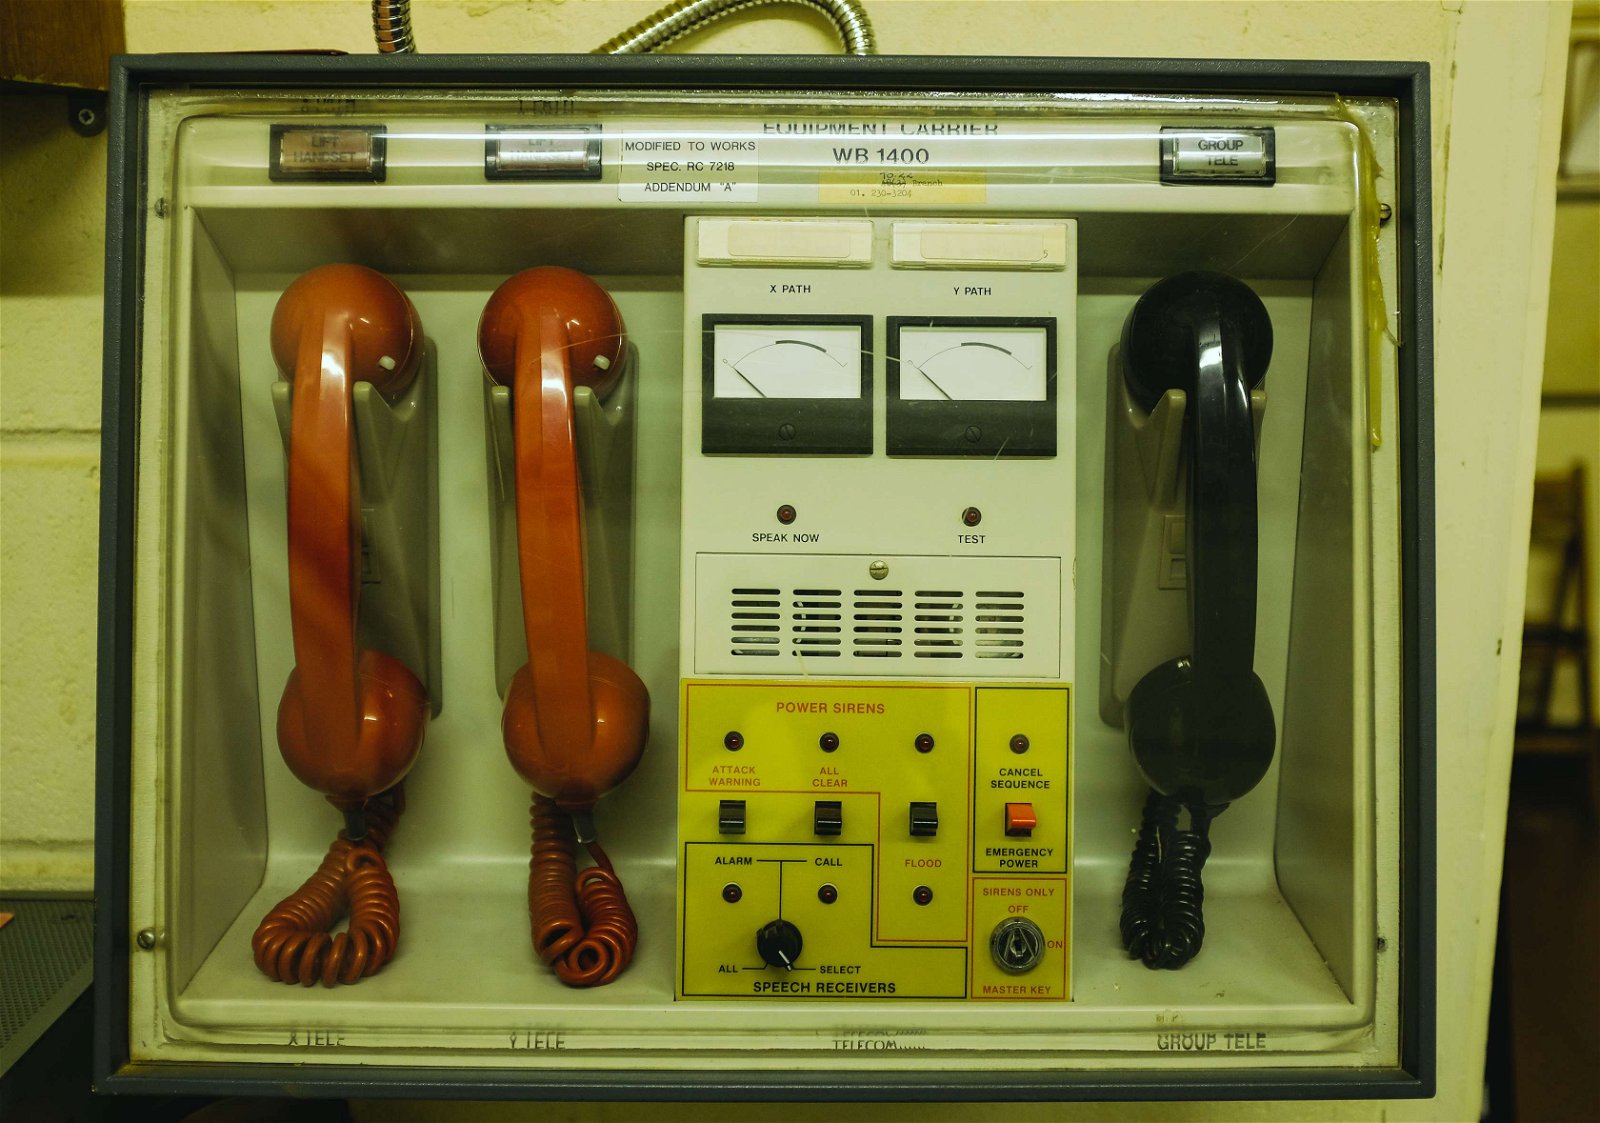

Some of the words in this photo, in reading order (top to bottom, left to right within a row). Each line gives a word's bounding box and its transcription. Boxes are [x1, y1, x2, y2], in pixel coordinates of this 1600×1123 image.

[625, 140, 681, 151] MODIFIED
[688, 141, 705, 151] TO
[710, 140, 756, 151] WORKS
[1197, 139, 1244, 151] GROUP
[832, 147, 869, 163] WB
[876, 147, 930, 164] 1400
[1207, 155, 1239, 166] TELE
[646, 162, 682, 172] SPEC.
[686, 162, 704, 172] RC
[709, 161, 735, 172] 7218
[644, 181, 711, 193] ADDENDUM
[769, 284, 777, 294] X
[782, 284, 812, 294] PATH
[953, 286, 960, 297] Y
[964, 286, 992, 297] PATH
[752, 532, 788, 543] SPEAK
[793, 533, 820, 543] NOW
[957, 534, 986, 544] TEST
[776, 702, 829, 714] POWER
[832, 702, 886, 715] SIRENS
[712, 765, 756, 775] ATTACK
[819, 766, 840, 776] ALL
[998, 767, 1044, 778] CANCEL
[708, 777, 761, 788] WARNING
[812, 778, 848, 788] CLEAR
[990, 779, 1051, 790] SEQUENCE
[985, 847, 1054, 858] EMERGENCY
[714, 856, 753, 866] ALARM
[814, 857, 843, 867] CALL
[904, 858, 942, 869] FLOOD
[999, 859, 1039, 869] POWER
[982, 887, 1022, 897] SIRENS
[1025, 887, 1055, 897] ONLY
[1007, 904, 1029, 914] OFF
[1046, 940, 1063, 950] ON
[718, 964, 738, 974] ALL
[819, 965, 861, 975] SELECT
[753, 981, 810, 993] SPEECH
[816, 981, 896, 994] RECEIVERS
[982, 984, 1026, 994] MASTER
[1030, 985, 1051, 995] KEY
[1157, 1032, 1217, 1050] GROUP
[1223, 1032, 1267, 1050] TELE
